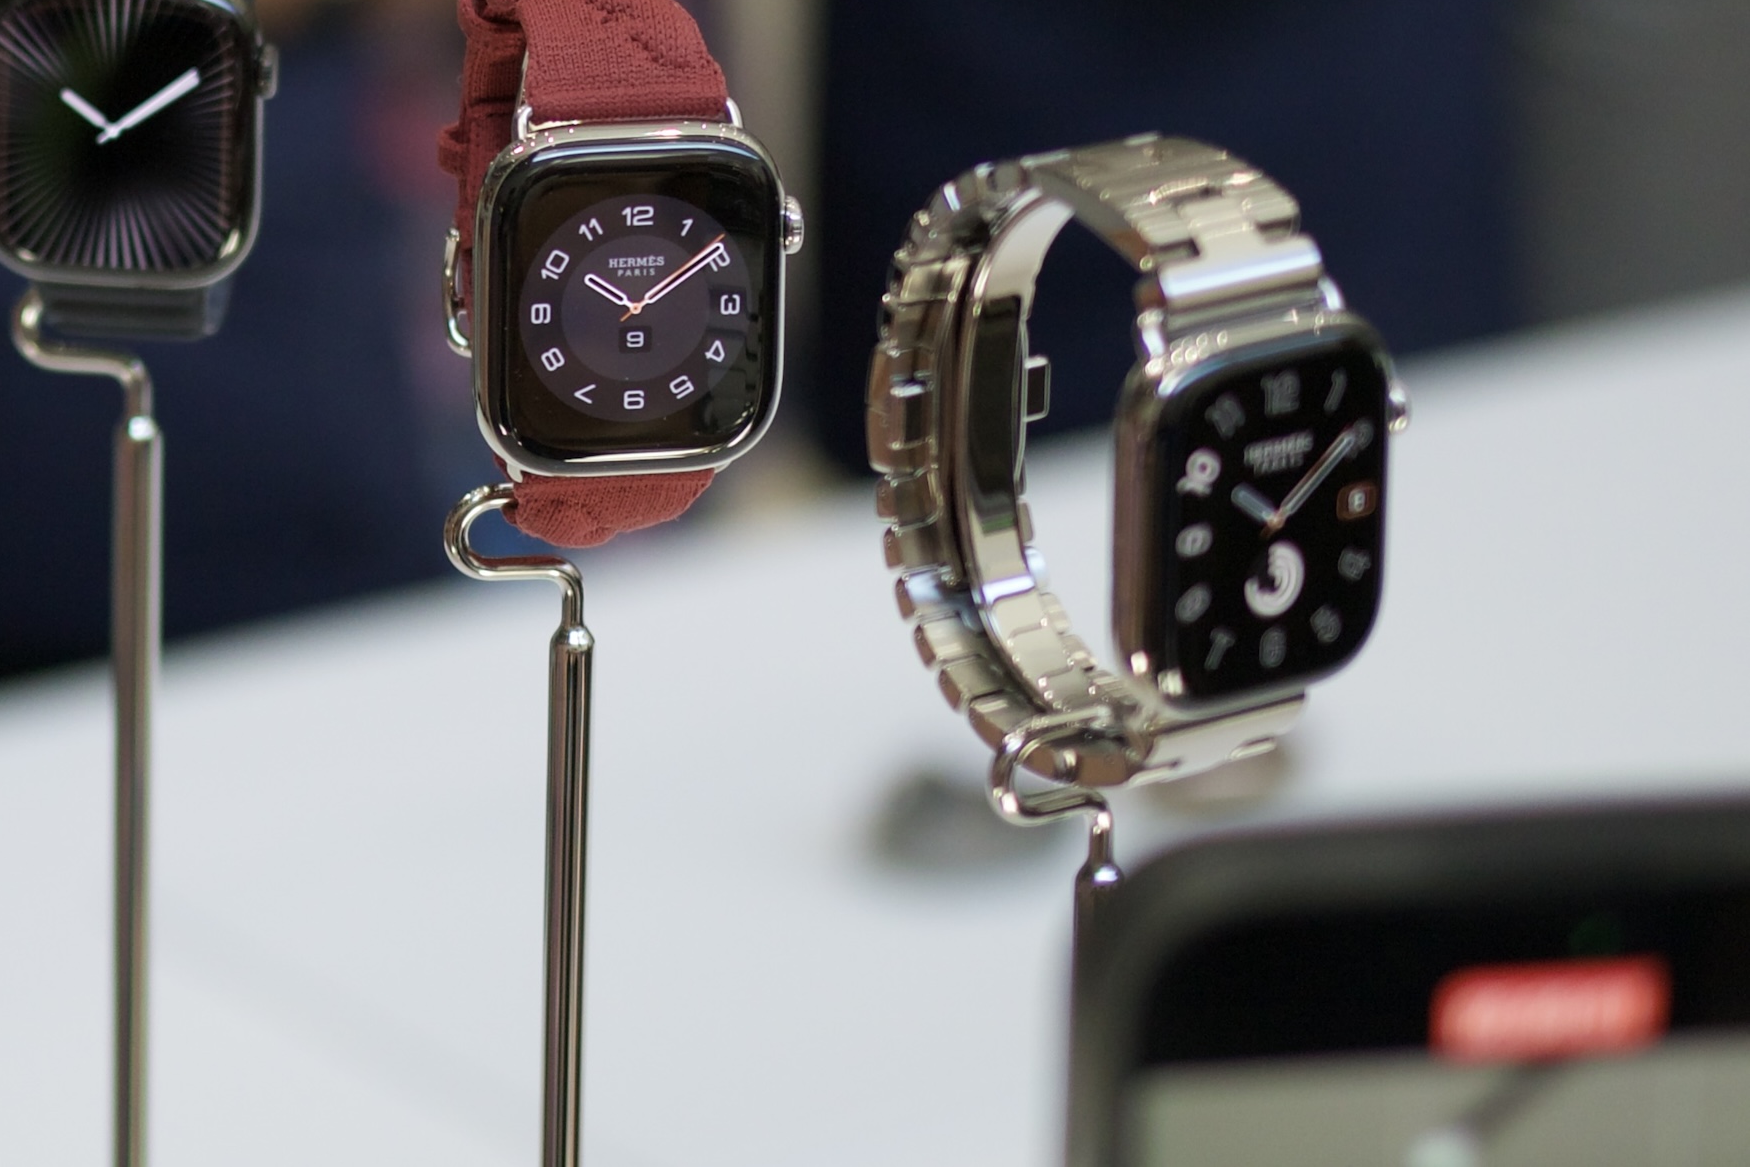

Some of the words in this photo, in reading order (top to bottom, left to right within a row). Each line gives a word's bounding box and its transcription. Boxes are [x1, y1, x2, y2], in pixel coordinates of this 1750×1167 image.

[621, 206, 654, 226] 12
[579, 218, 603, 241] 11
[681, 219, 694, 236] 1
[541, 249, 570, 280] 10
[608, 255, 665, 268] HERMÈS
[617, 268, 656, 277] PARIS
[531, 303, 551, 324] 9
[720, 294, 741, 315] 3
[626, 331, 645, 348] 9
[541, 347, 565, 371] 8
[705, 340, 726, 362] 4
[574, 384, 597, 404] 7
[669, 375, 695, 399] 5
